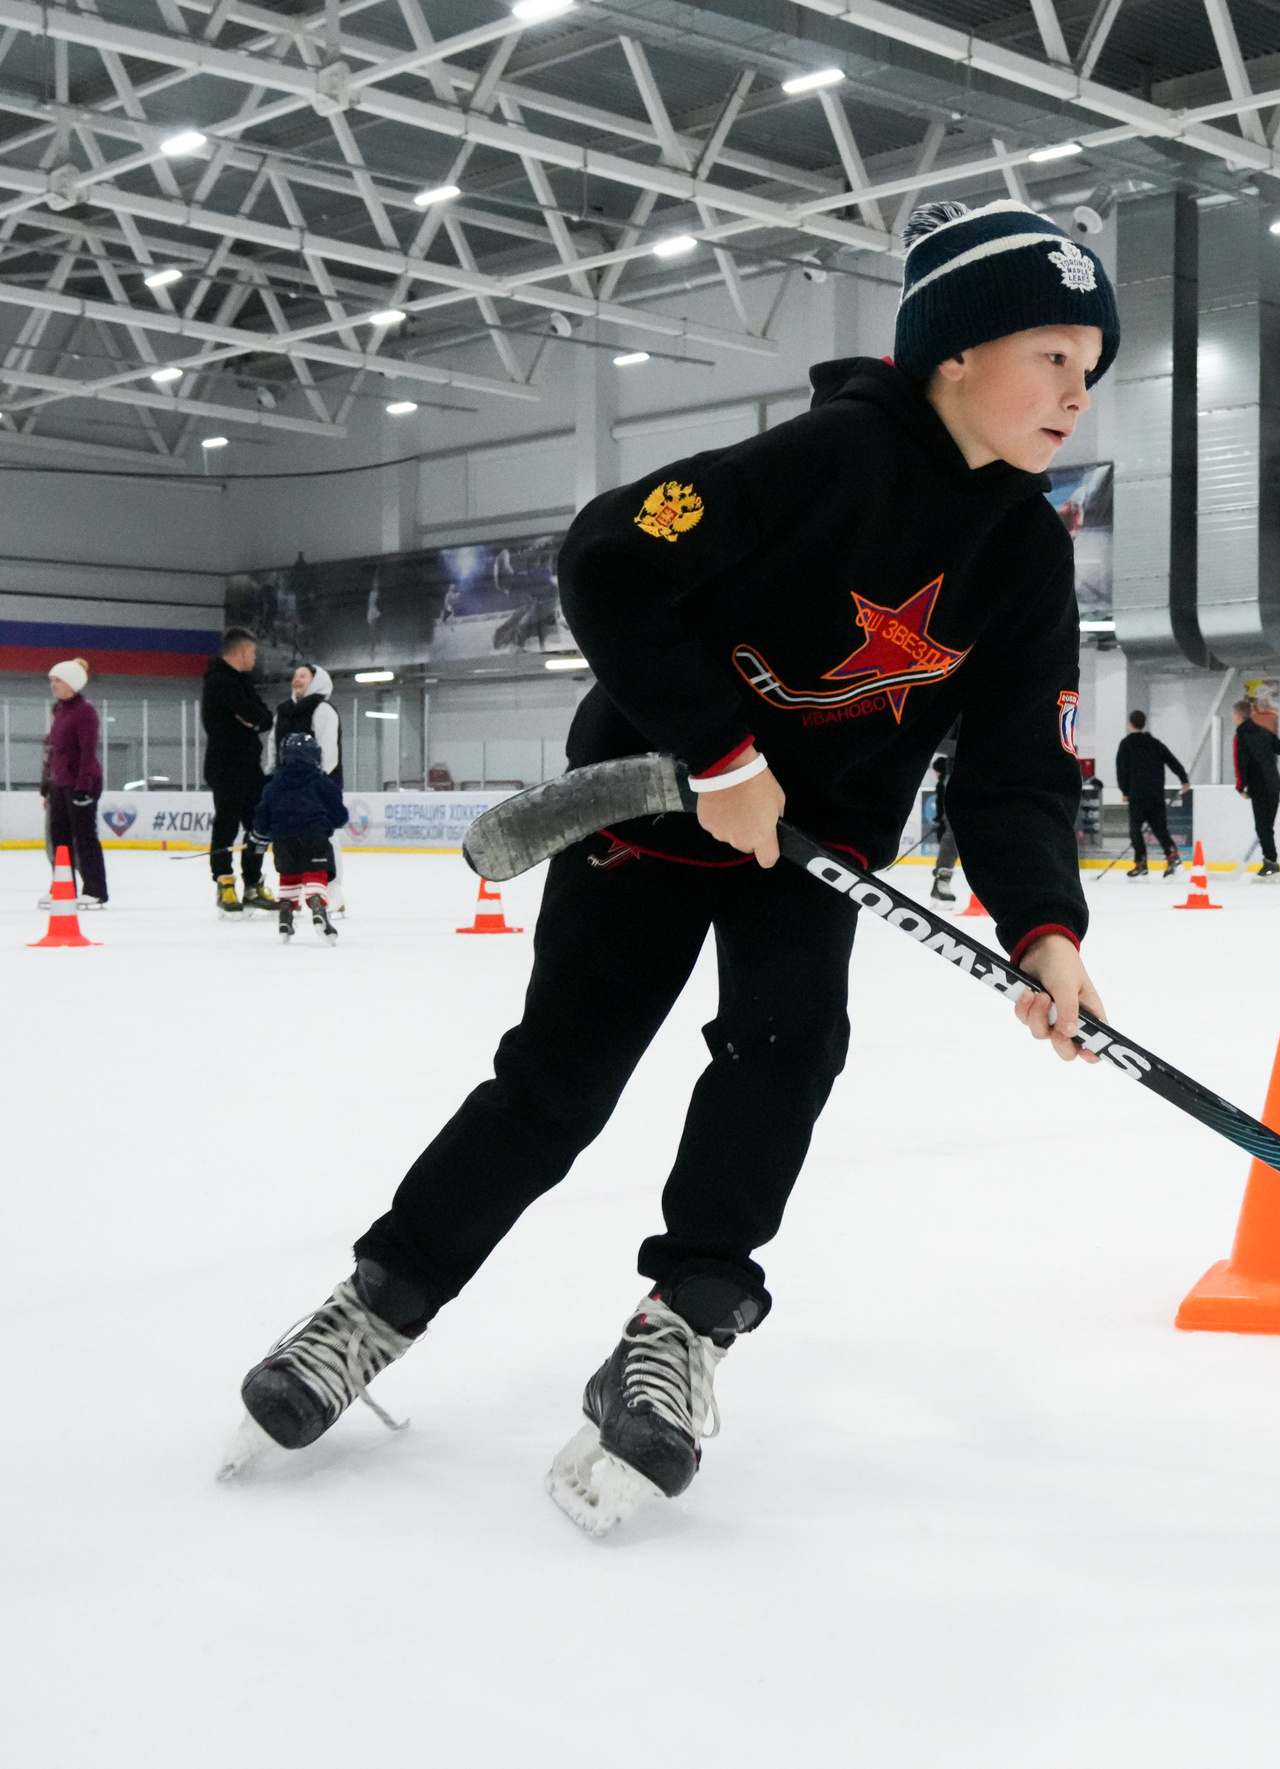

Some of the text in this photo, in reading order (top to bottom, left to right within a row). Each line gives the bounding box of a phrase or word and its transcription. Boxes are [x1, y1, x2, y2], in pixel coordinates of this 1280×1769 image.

[1060, 259, 1091, 271] TORONTO
[1066, 267, 1089, 276] MAPLE
[1068, 275, 1090, 283] LEAFS
[881, 619, 952, 675] ЗВЕЗДА
[801, 696, 887, 727] ИВАНОВО
[806, 856, 1152, 1081] SHR-WOOD
